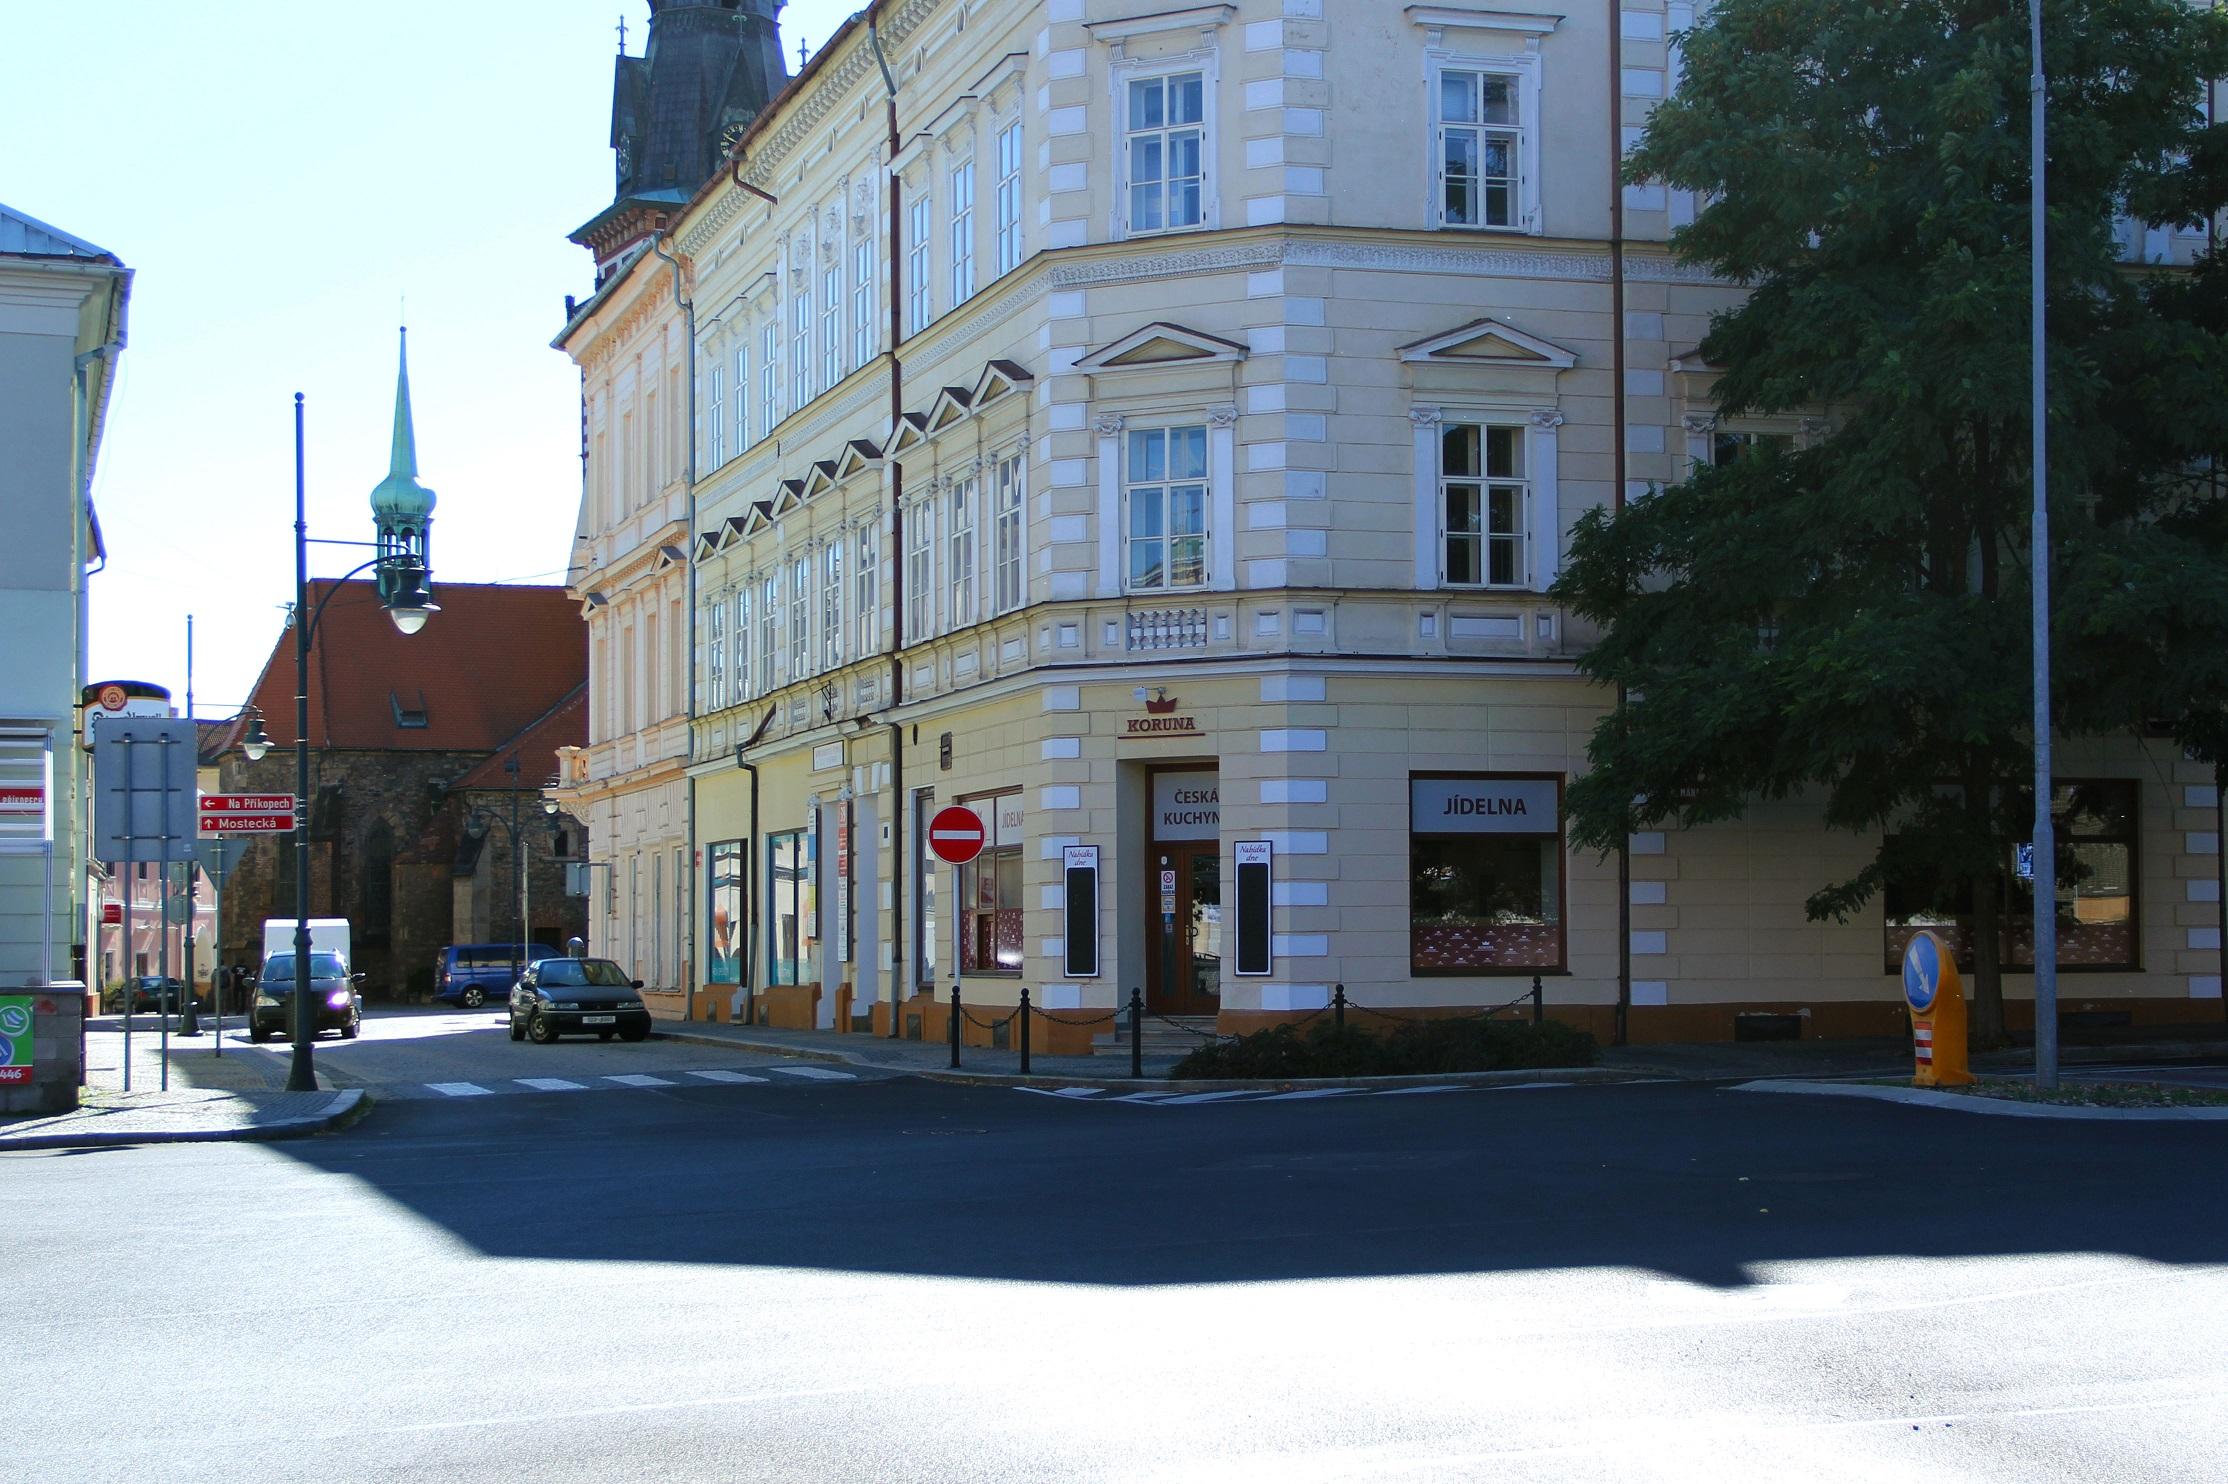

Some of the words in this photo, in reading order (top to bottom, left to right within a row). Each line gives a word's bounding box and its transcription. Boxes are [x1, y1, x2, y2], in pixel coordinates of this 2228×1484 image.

[1127, 717, 1196, 732] KORUNA
[228, 798, 240, 809] Na
[244, 797, 290, 810] Příkopech
[1174, 788, 1219, 804] ČESKÁ
[1442, 794, 1527, 815] JÍDELNA
[219, 817, 277, 829] Mostecká
